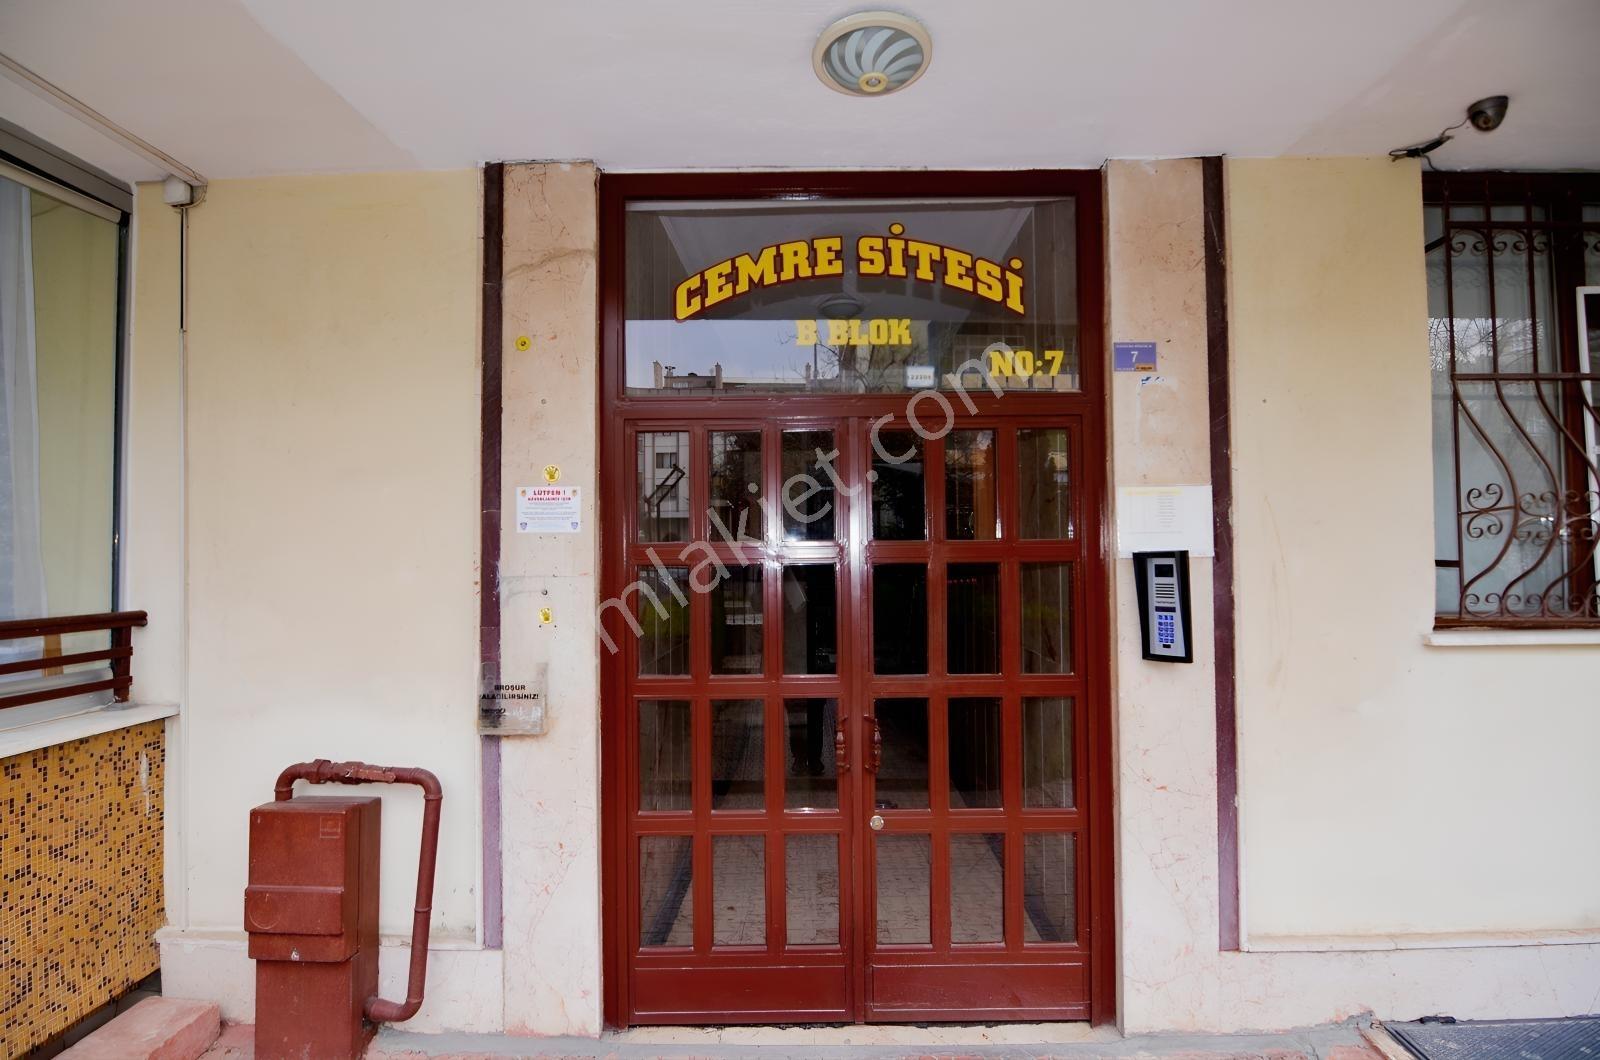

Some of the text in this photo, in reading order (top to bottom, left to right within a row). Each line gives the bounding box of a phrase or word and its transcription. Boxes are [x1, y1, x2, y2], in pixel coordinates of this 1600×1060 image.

[675, 222, 1025, 322] CEMRE SİTESİ
[796, 318, 912, 346] B BLOK
[990, 350, 1064, 377] NO:7
[1131, 351, 1138, 363] 7
